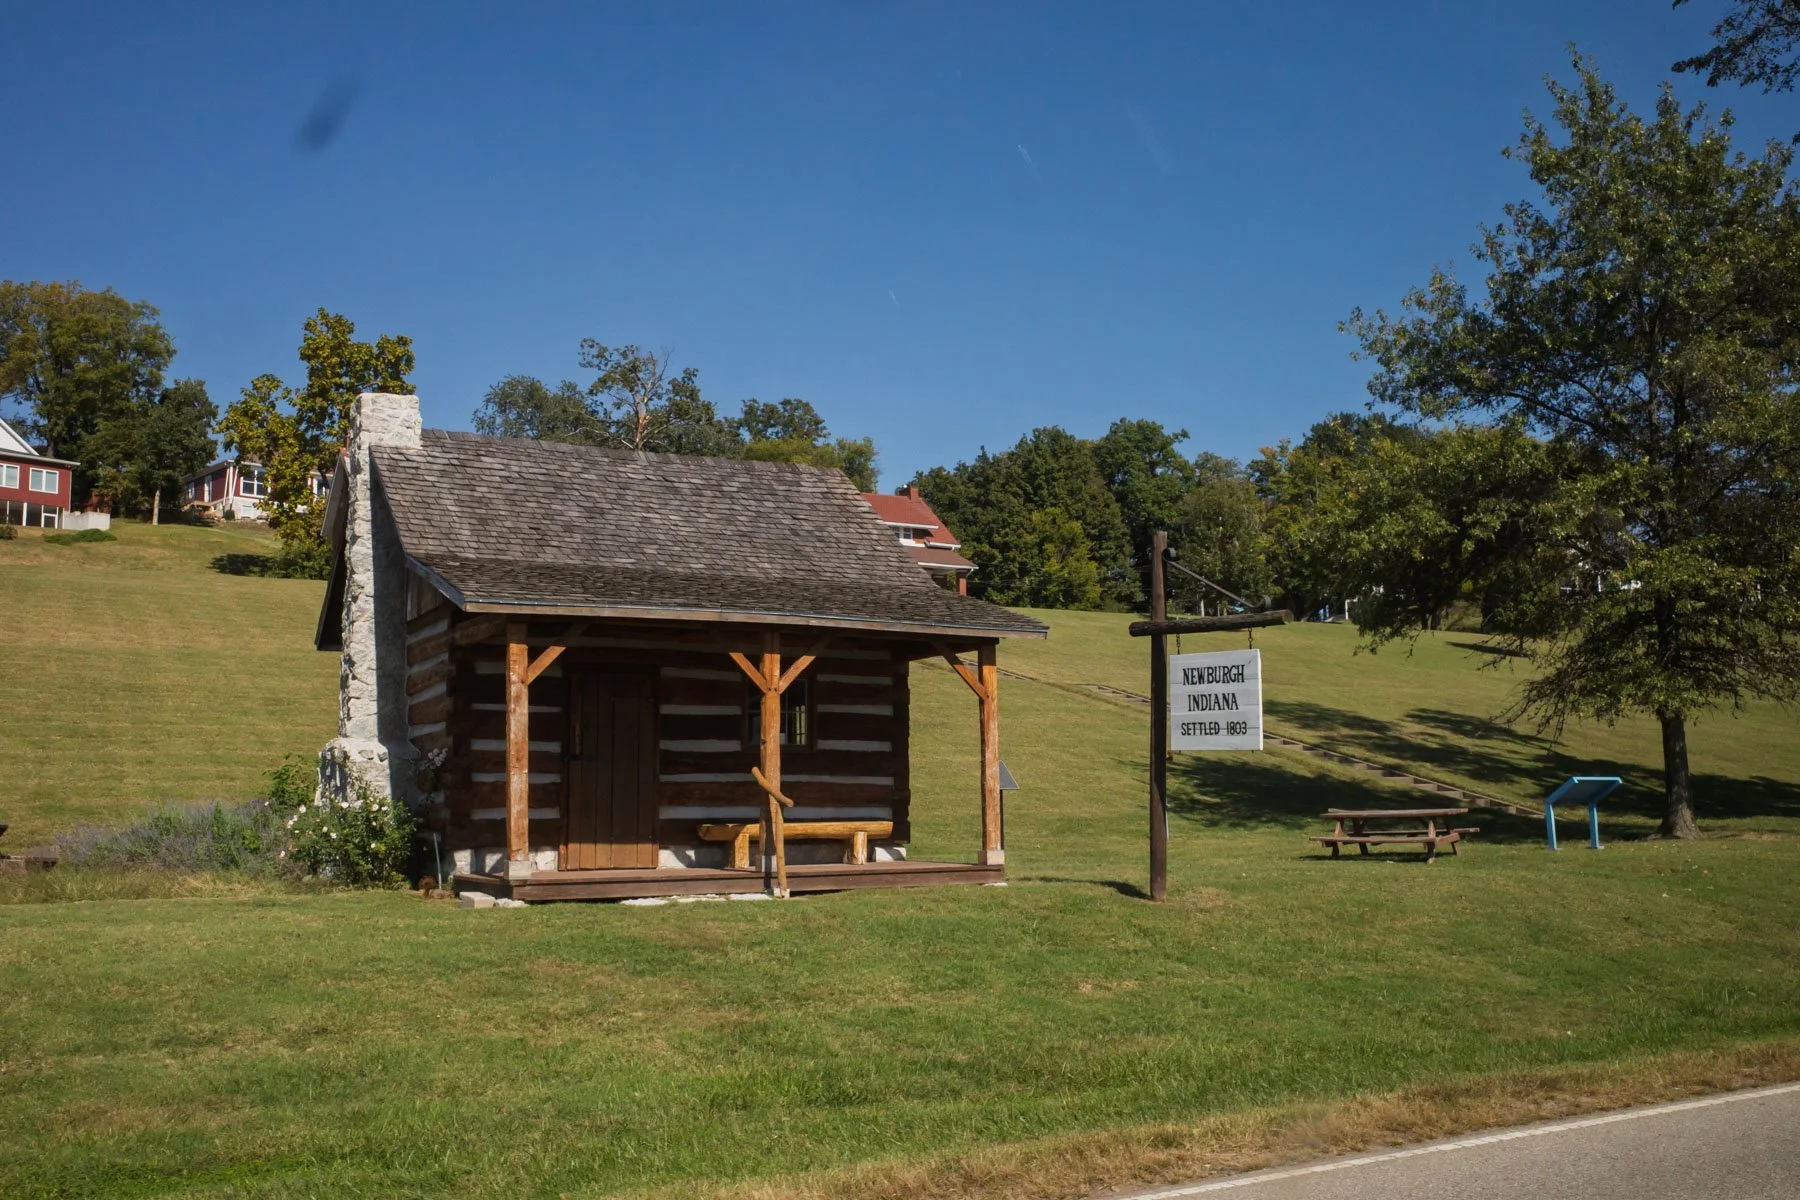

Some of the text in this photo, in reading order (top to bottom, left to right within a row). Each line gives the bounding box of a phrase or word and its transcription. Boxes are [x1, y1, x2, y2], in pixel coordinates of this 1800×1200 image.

[1182, 665, 1245, 686] NEWBURGH
[1188, 693, 1239, 711] INDIANA
[1181, 721, 1248, 736] SETTLED 1803
